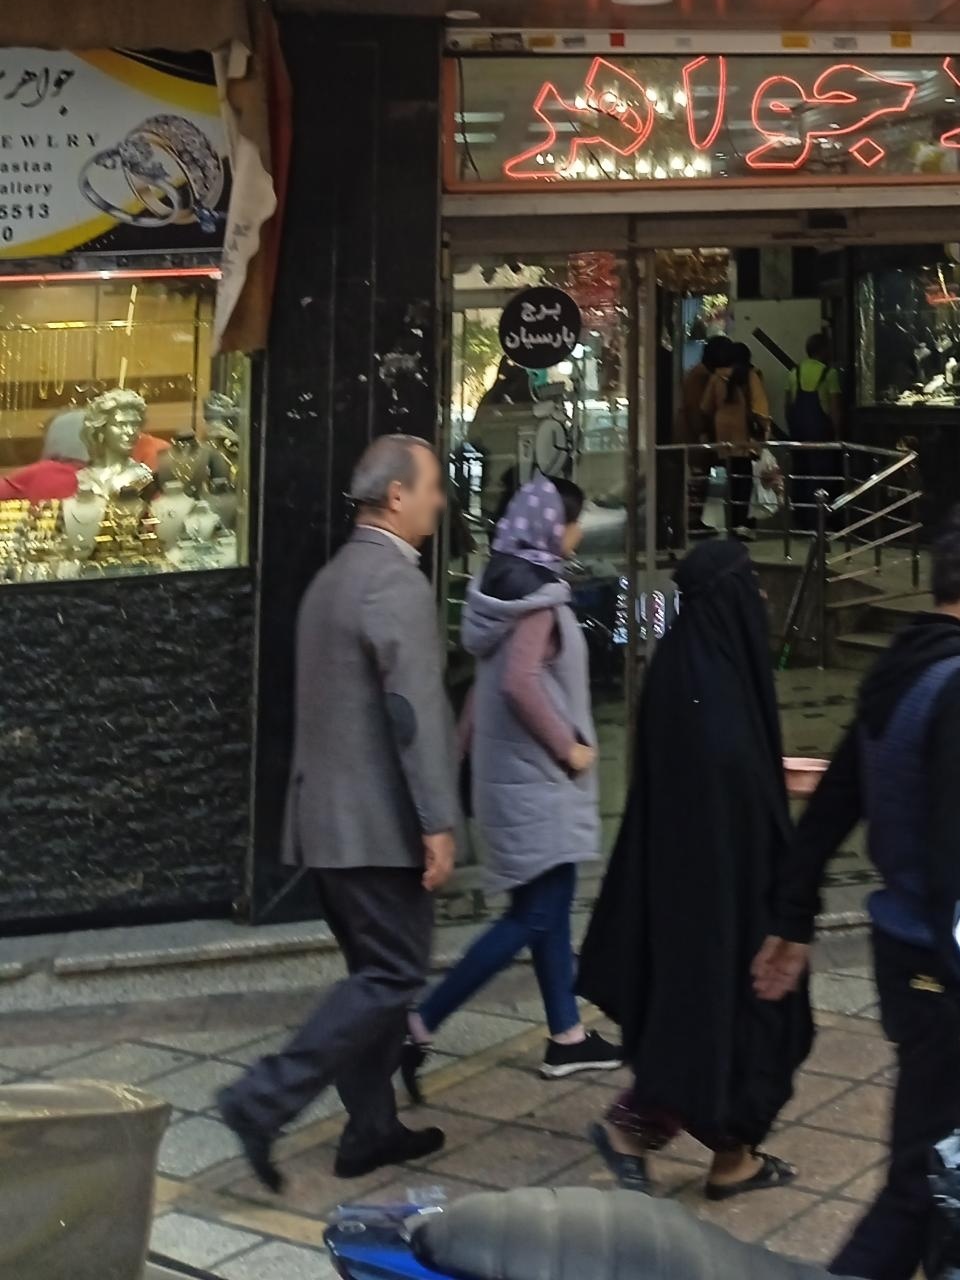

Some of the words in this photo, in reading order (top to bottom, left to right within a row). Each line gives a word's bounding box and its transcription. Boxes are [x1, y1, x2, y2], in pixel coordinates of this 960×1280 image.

[504, 56, 916, 179] جواهر
[521, 302, 561, 322] برج
[505, 325, 575, 349] پارسیان
